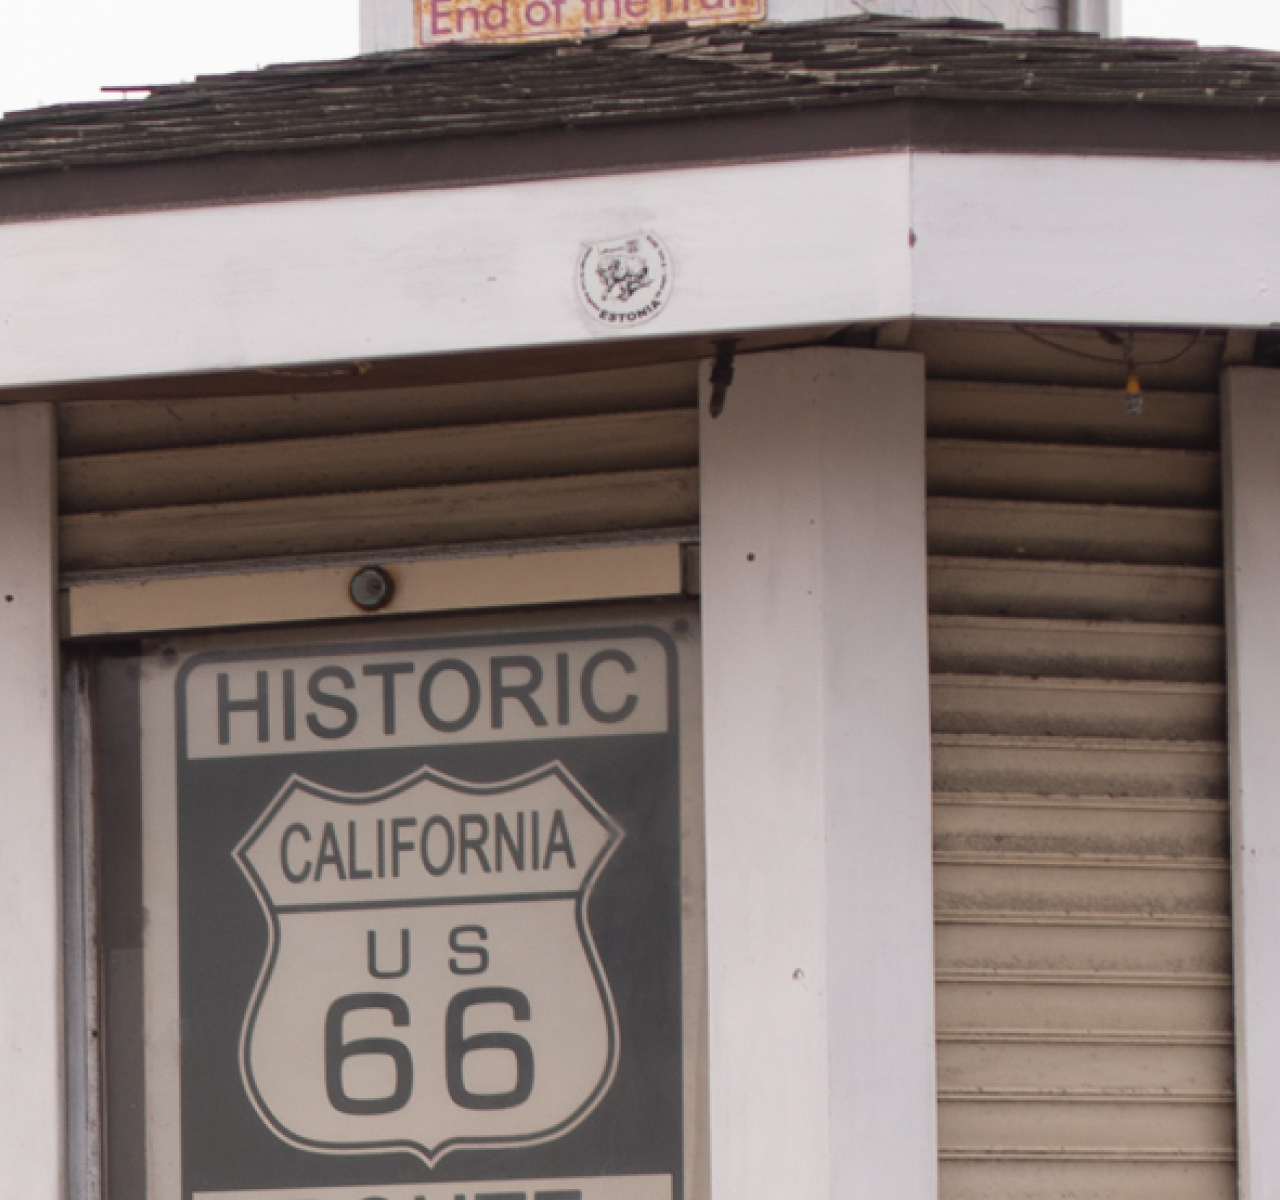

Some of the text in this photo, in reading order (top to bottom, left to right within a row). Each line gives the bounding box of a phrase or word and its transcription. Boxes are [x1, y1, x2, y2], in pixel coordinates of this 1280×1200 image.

[431, 0, 507, 35] End
[598, 300, 662, 323] ESTONIA
[216, 648, 640, 746] HISTORIC
[279, 809, 577, 884] CALIFORNIA
[324, 986, 536, 1116] 66
